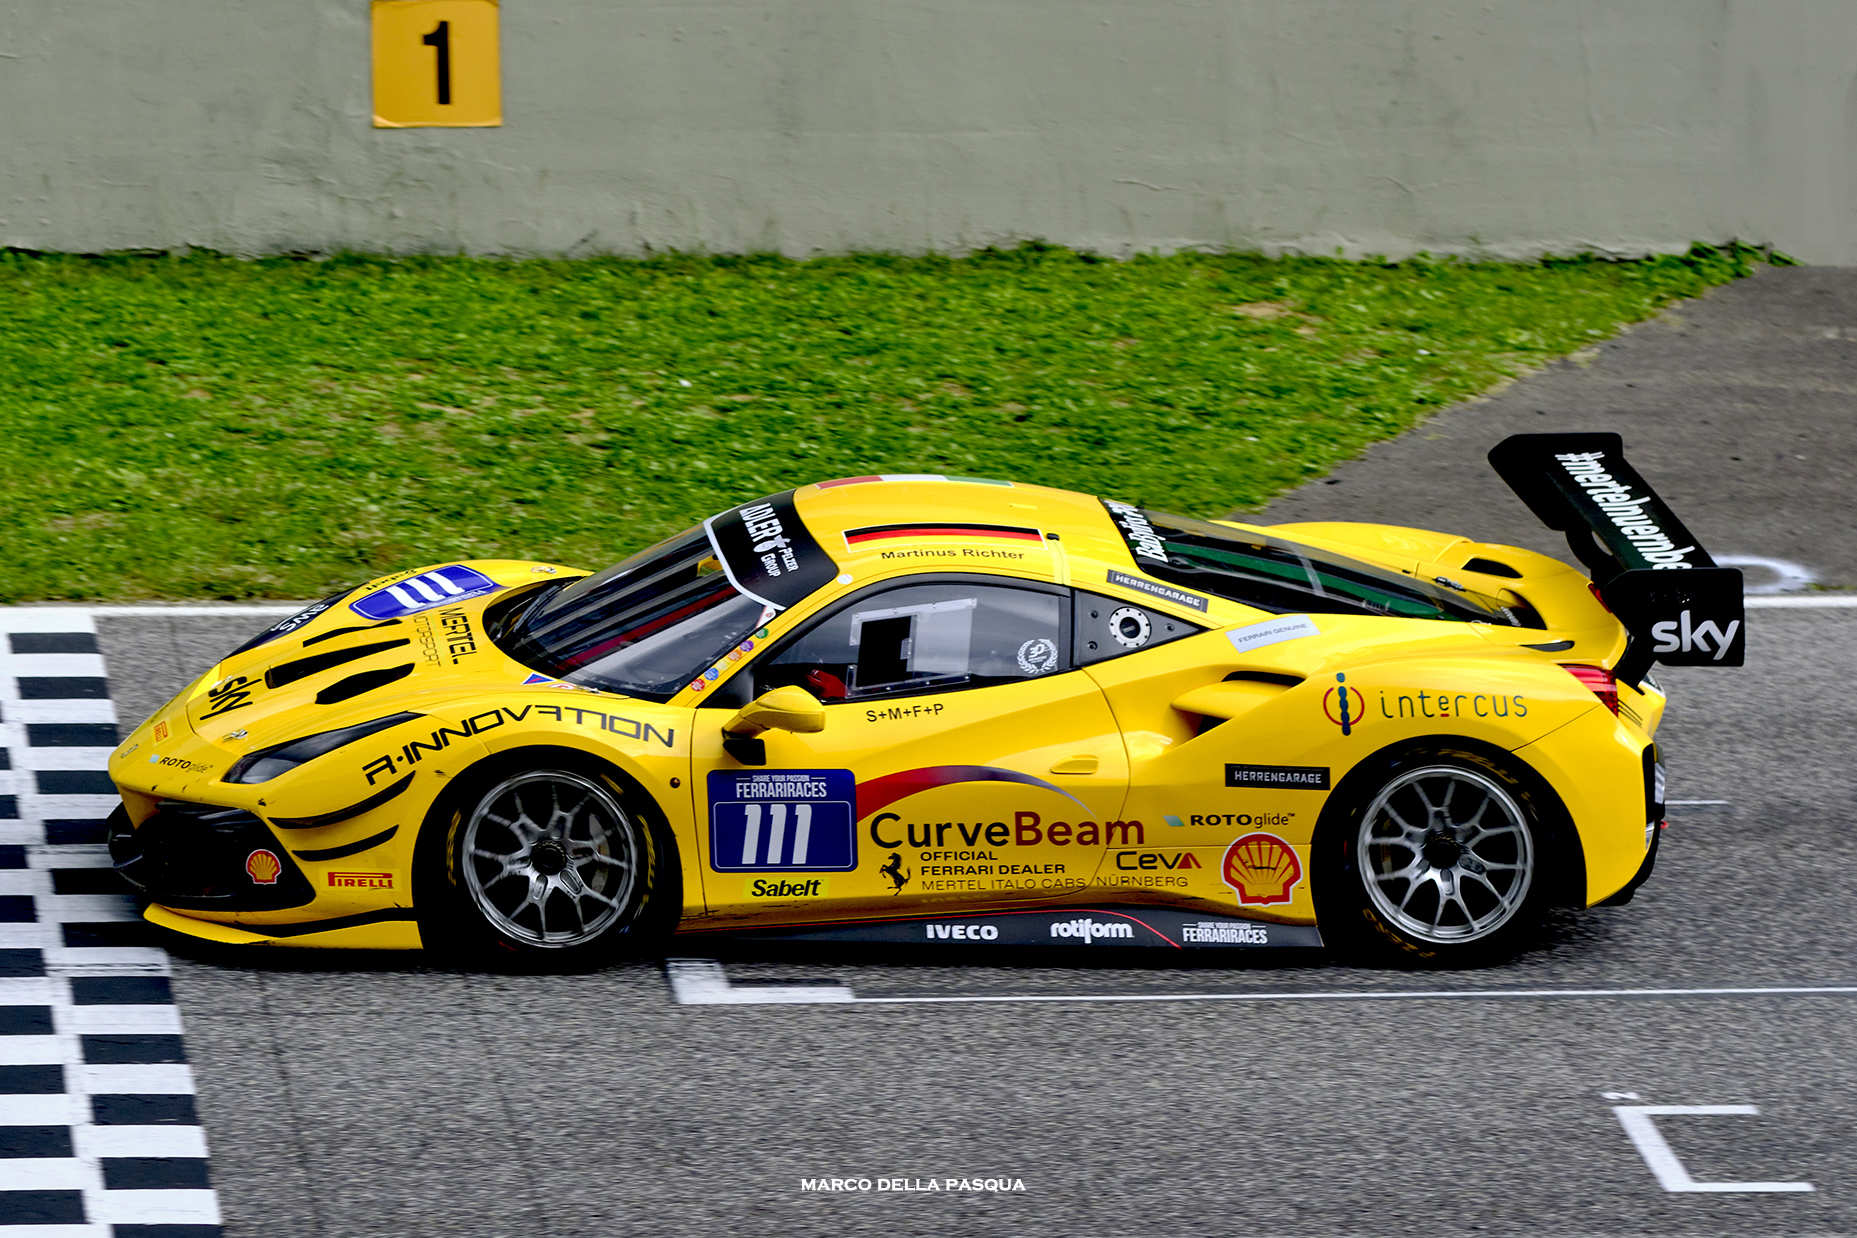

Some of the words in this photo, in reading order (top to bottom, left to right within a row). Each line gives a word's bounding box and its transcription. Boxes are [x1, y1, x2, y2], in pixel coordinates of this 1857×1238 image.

[422, 20, 450, 105] 1
[739, 503, 783, 542] ADLER
[778, 547, 799, 572] PELZER
[881, 549, 957, 560] Martinus
[962, 548, 1025, 560] Richter
[386, 571, 465, 608] 111
[1115, 575, 1200, 607] HERRENGARAGE
[438, 607, 477, 665] MERTEL
[1237, 629, 1273, 643] FERRARI
[1272, 622, 1308, 634] GENUINE
[1651, 609, 1740, 660] sky
[866, 703, 944, 722] S+M+F+P
[1380, 690, 1528, 718] intercus
[153, 721, 168, 742] PIRELLI
[752, 774, 770, 783] SHARE
[771, 774, 786, 782] YOUR
[786, 774, 810, 782] PASSION
[1234, 770, 1322, 784] HERRENGARAGE
[736, 782, 827, 798] FERRARIRACES
[741, 803, 813, 864] 111
[870, 811, 1145, 849] CurveBeam
[920, 850, 998, 862] OFFICIAL
[327, 871, 393, 888] PIRELLI
[921, 864, 994, 876] FERRARI
[999, 863, 1066, 875] DEALER
[751, 878, 821, 897] Sabelt
[922, 879, 985, 891] MERTEL
[991, 878, 1036, 890] ITALO
[1042, 877, 1086, 889] CABS
[1096, 874, 1188, 888] NÜRNBERG
[926, 924, 999, 940] IVECO
[1050, 918, 1134, 944] rotiform
[1182, 927, 1268, 944] FERRARIRACES
